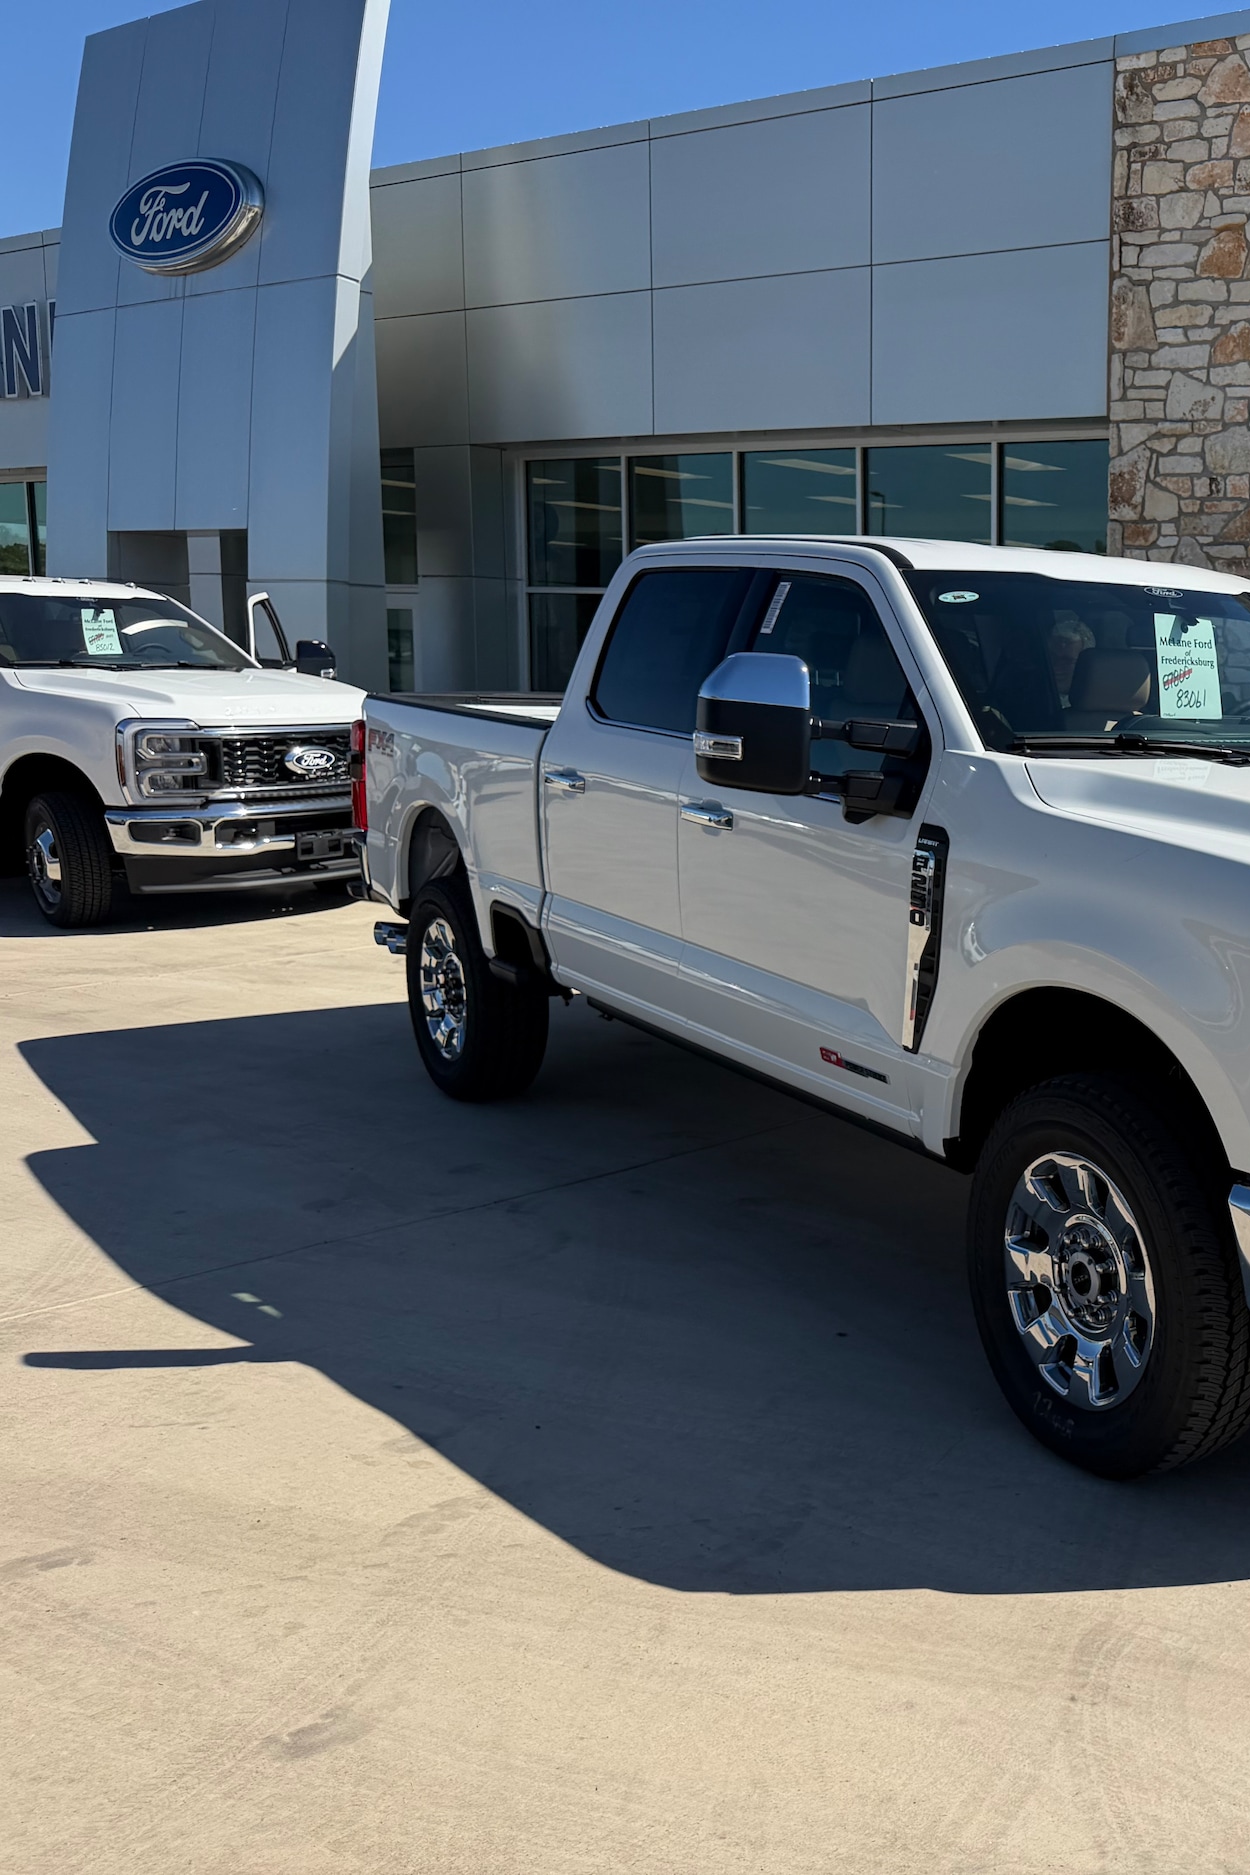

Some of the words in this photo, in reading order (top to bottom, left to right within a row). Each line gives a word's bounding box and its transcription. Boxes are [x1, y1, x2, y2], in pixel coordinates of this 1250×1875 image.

[130, 181, 210, 246] Ford
[0, 298, 56, 398] N
[1193, 639, 1213, 649] Ford
[1161, 656, 1214, 669] Fredericksburg
[1176, 688, 1207, 708] 83061
[300, 753, 328, 766] Ford
